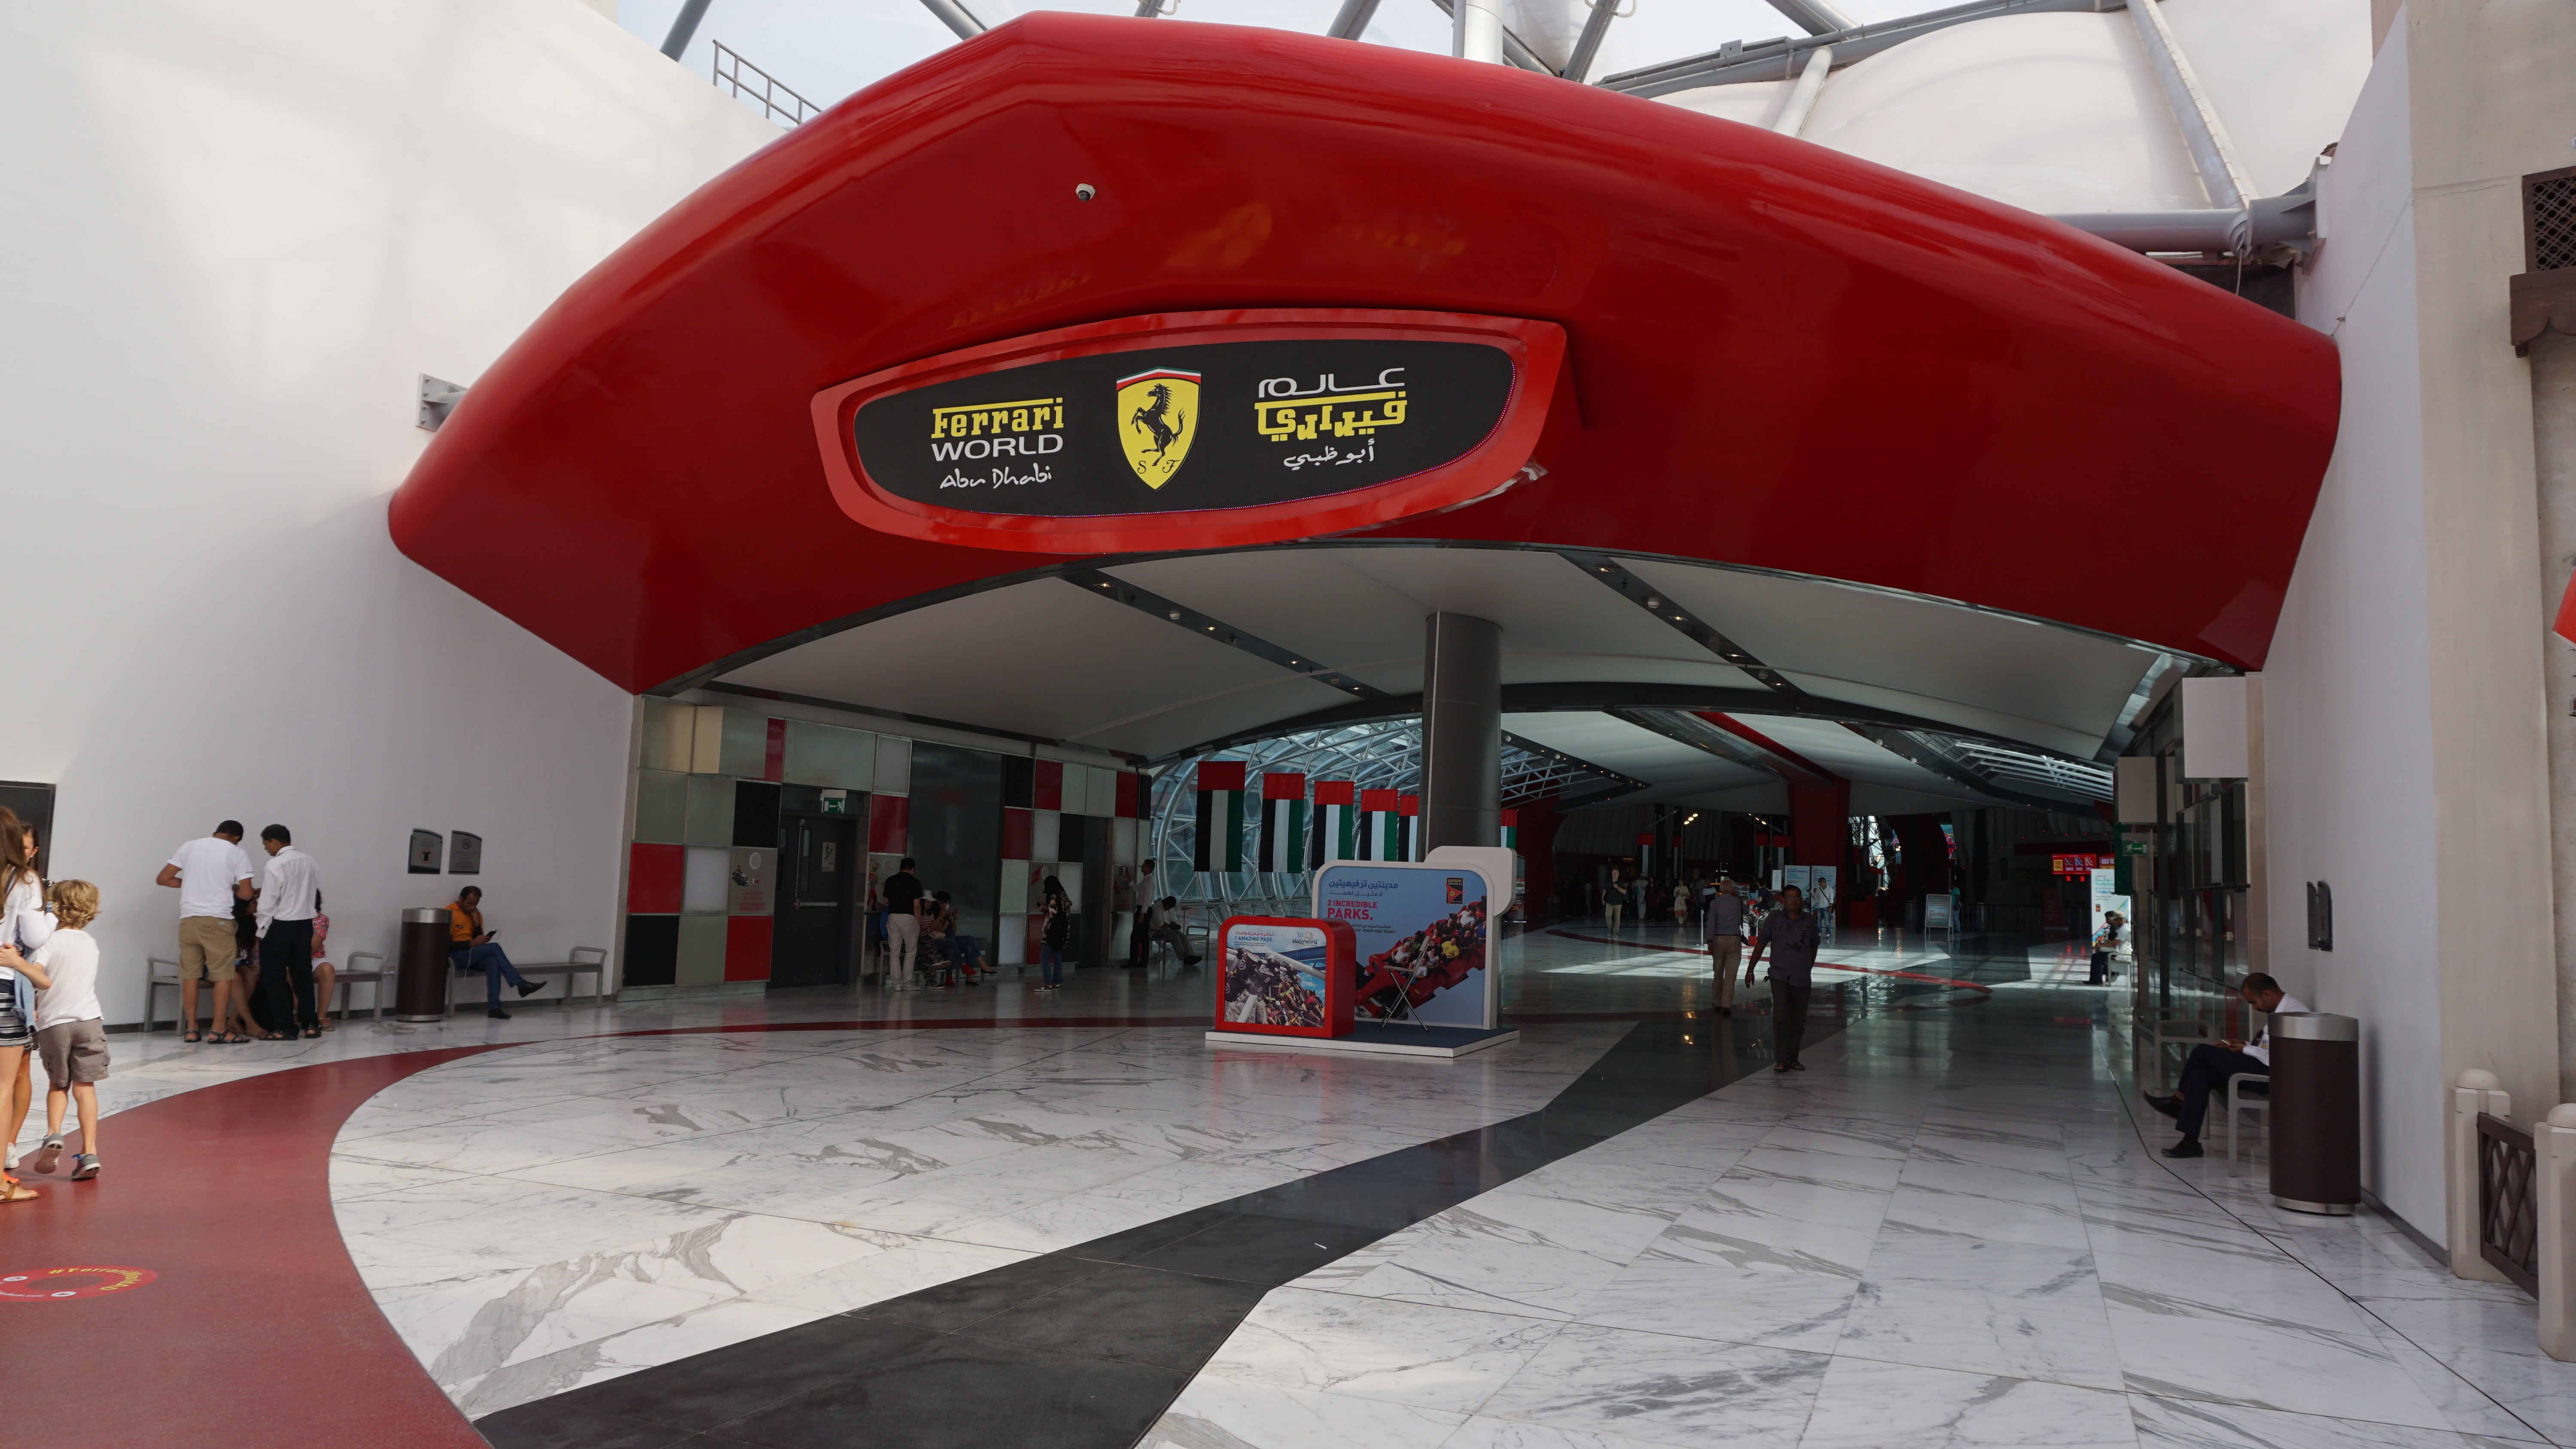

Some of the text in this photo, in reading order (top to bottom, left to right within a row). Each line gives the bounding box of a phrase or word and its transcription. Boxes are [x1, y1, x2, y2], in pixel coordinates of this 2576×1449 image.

[1258, 367, 1406, 398] عالم
[931, 397, 1064, 439] Ferrari
[1254, 391, 1408, 442] فيراري
[931, 433, 1064, 462] WORLD
[939, 463, 1053, 490] Abu Dhabi
[1136, 459, 1182, 474] S F
[1329, 879, 1398, 890] مدينتين ترفيهيتين
[1327, 908, 1373, 920] PARKS.
[1334, 900, 1377, 908] INCREDIBLE
